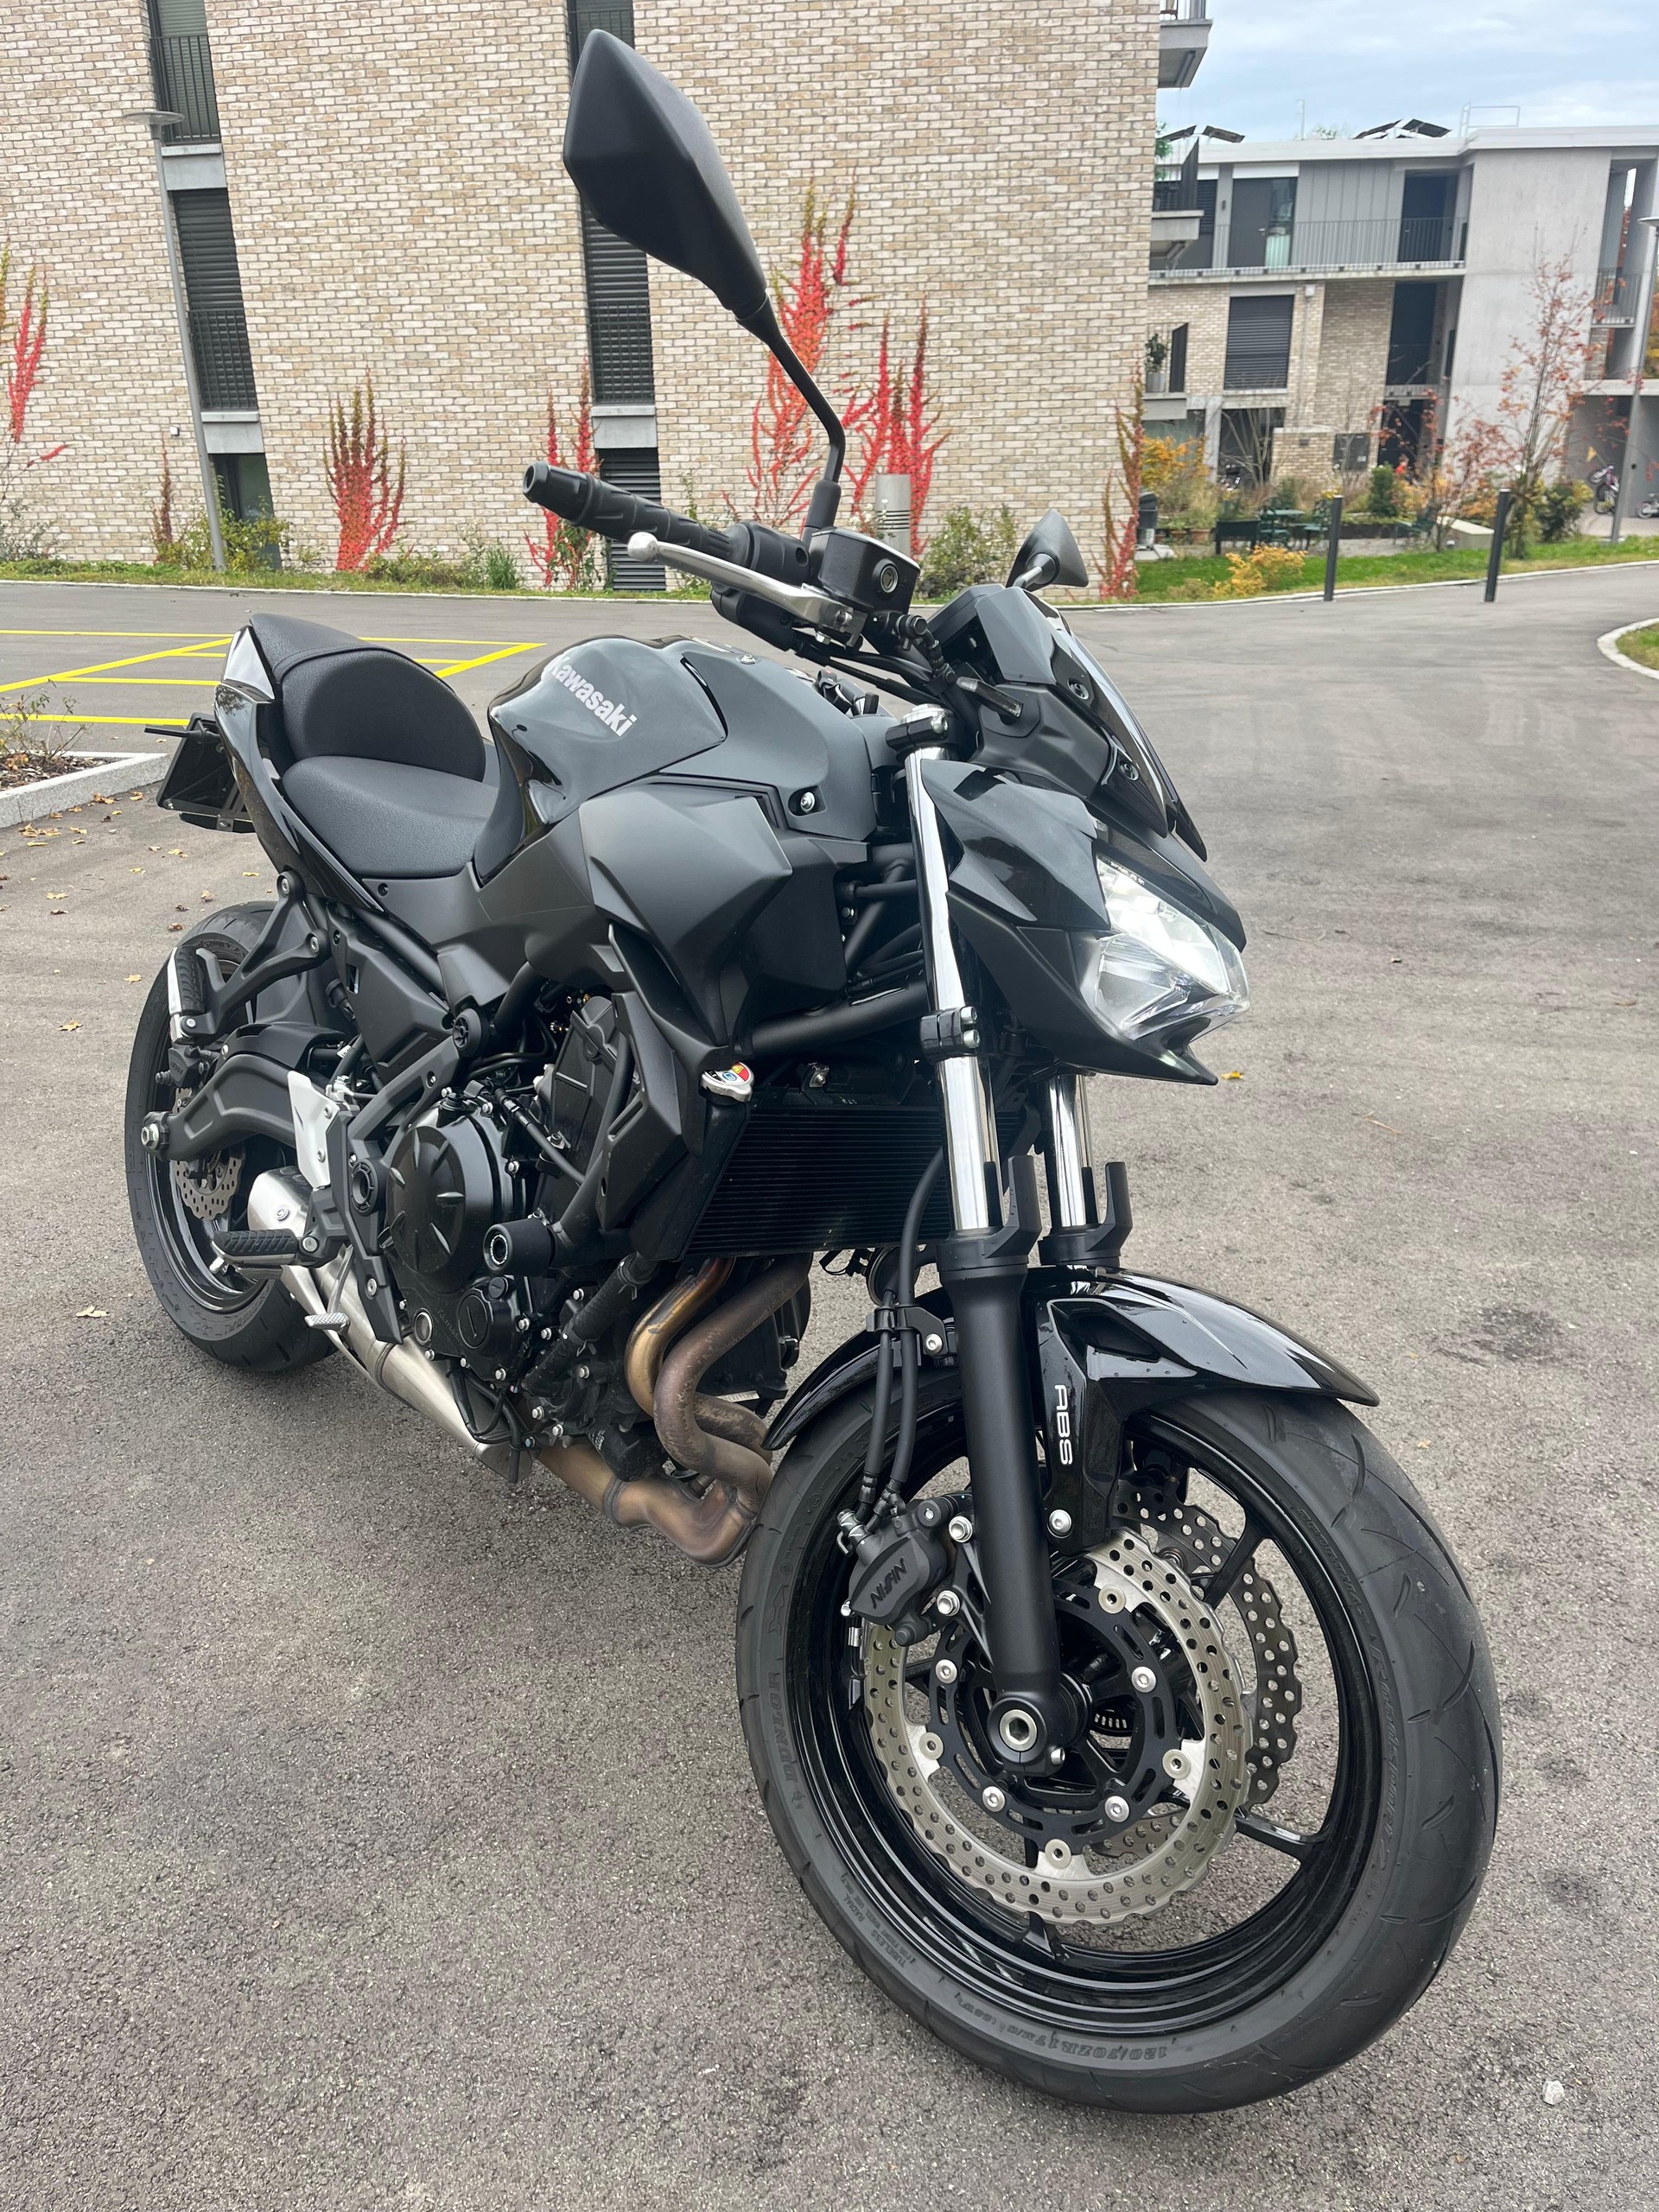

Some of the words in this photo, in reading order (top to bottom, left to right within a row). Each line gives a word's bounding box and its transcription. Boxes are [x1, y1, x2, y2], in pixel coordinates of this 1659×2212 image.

[549, 656, 638, 737] Kawasaki
[1054, 1384, 1073, 1465] ABS
[870, 1556, 907, 1609] NISSIN
[768, 1672, 798, 1783] DUNLOP
[844, 1893, 864, 1923] RADIAL
[871, 1929, 906, 1967] TUBELESS
